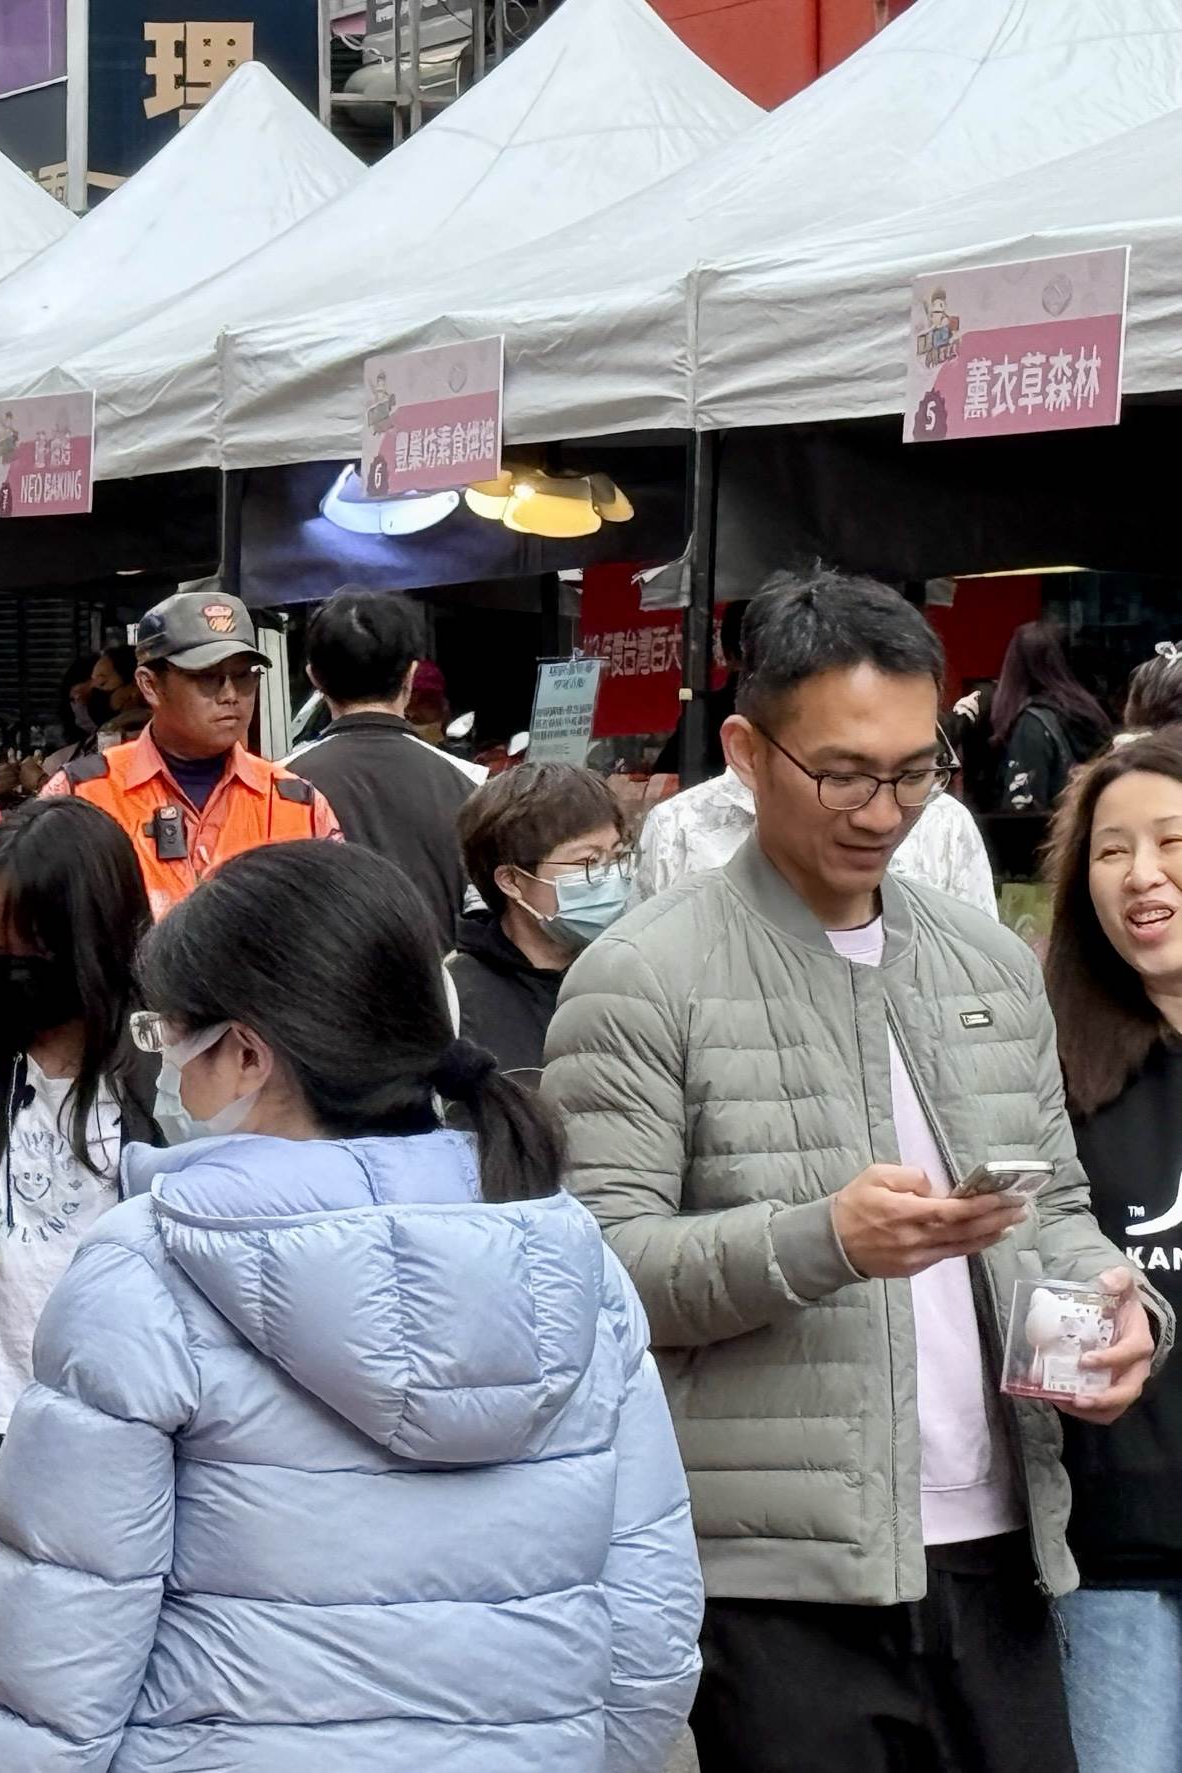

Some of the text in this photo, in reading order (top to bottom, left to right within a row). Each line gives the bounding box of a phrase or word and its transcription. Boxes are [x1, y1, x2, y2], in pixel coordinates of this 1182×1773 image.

[924, 400, 937, 432] 5
[20, 473, 43, 504] NEO
[43, 469, 83, 503] BAKING
[374, 463, 383, 489] 6
